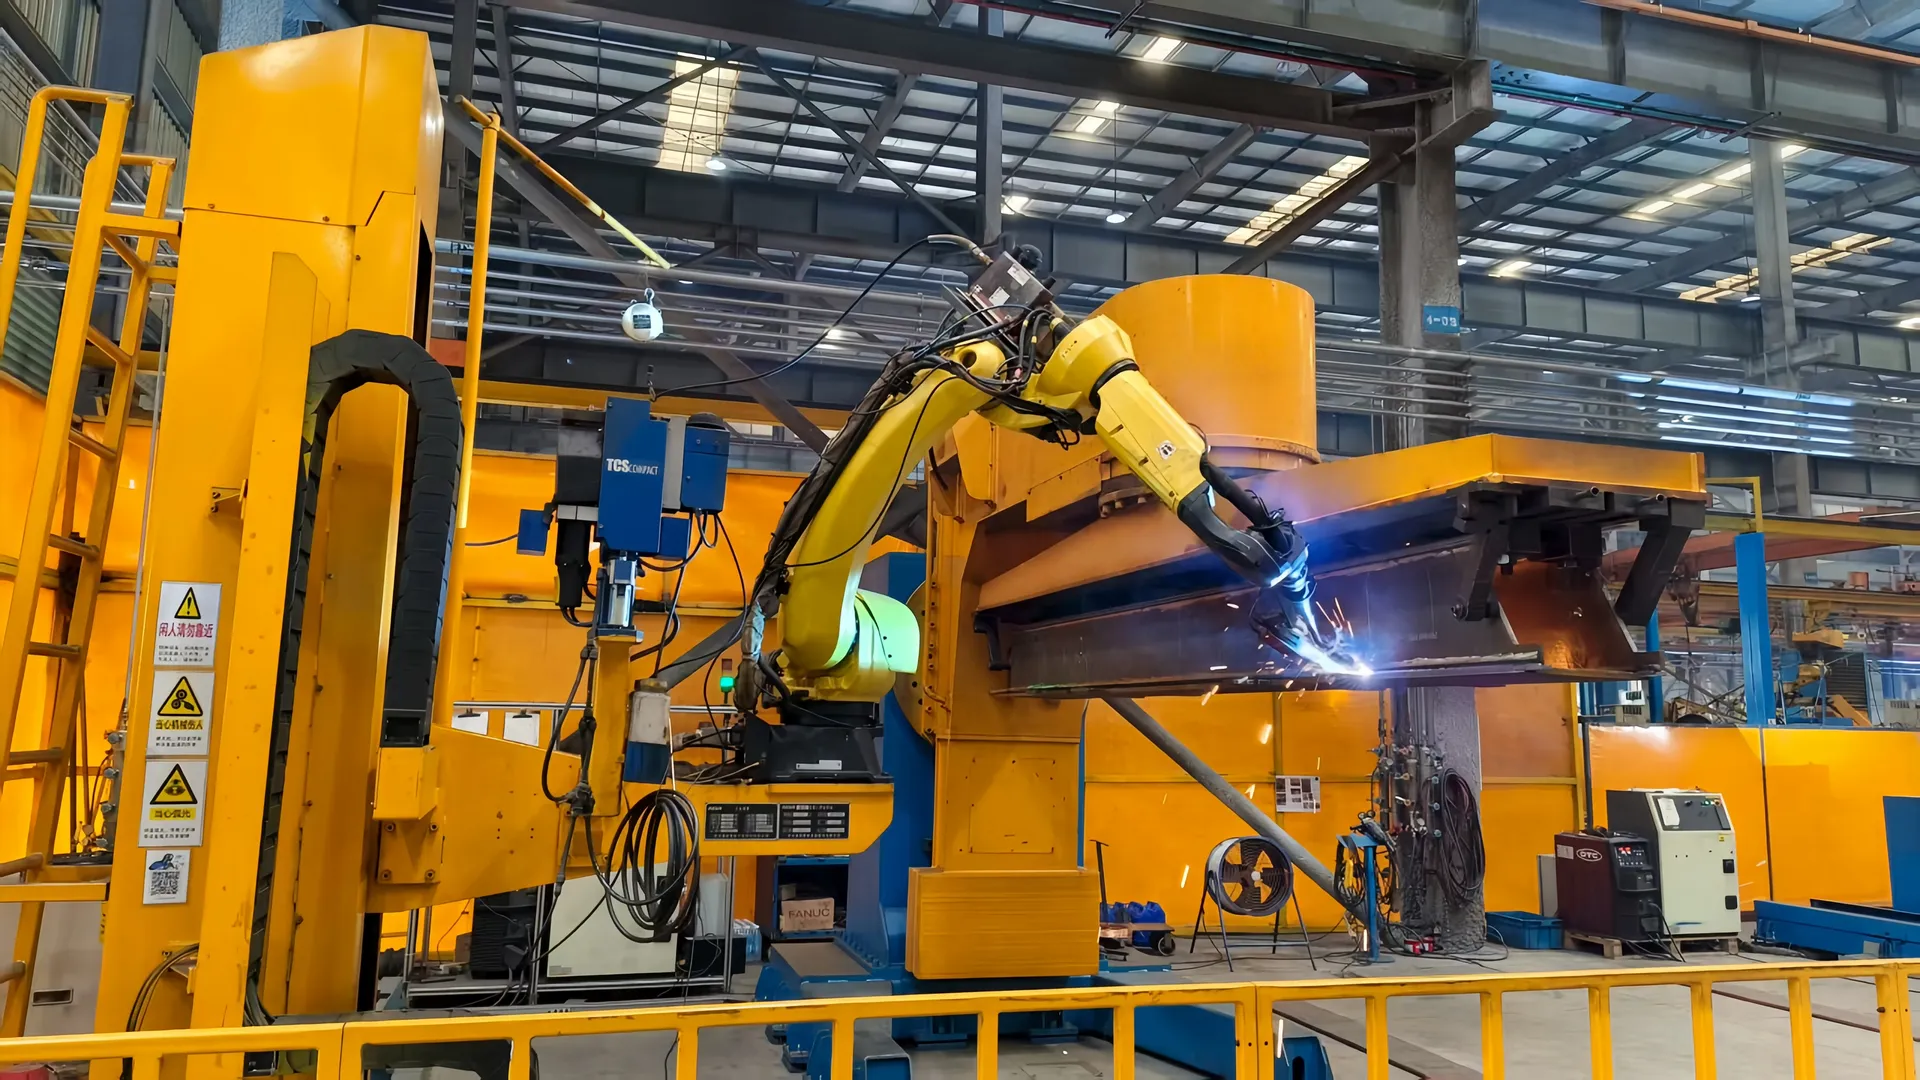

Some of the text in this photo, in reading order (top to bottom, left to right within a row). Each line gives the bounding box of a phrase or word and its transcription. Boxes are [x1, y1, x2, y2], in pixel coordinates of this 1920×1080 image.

[606, 458, 629, 472] TCS
[158, 622, 214, 638] 闲人请勿靠近
[1579, 851, 1598, 859] OTC
[788, 908, 830, 919] FANUC
